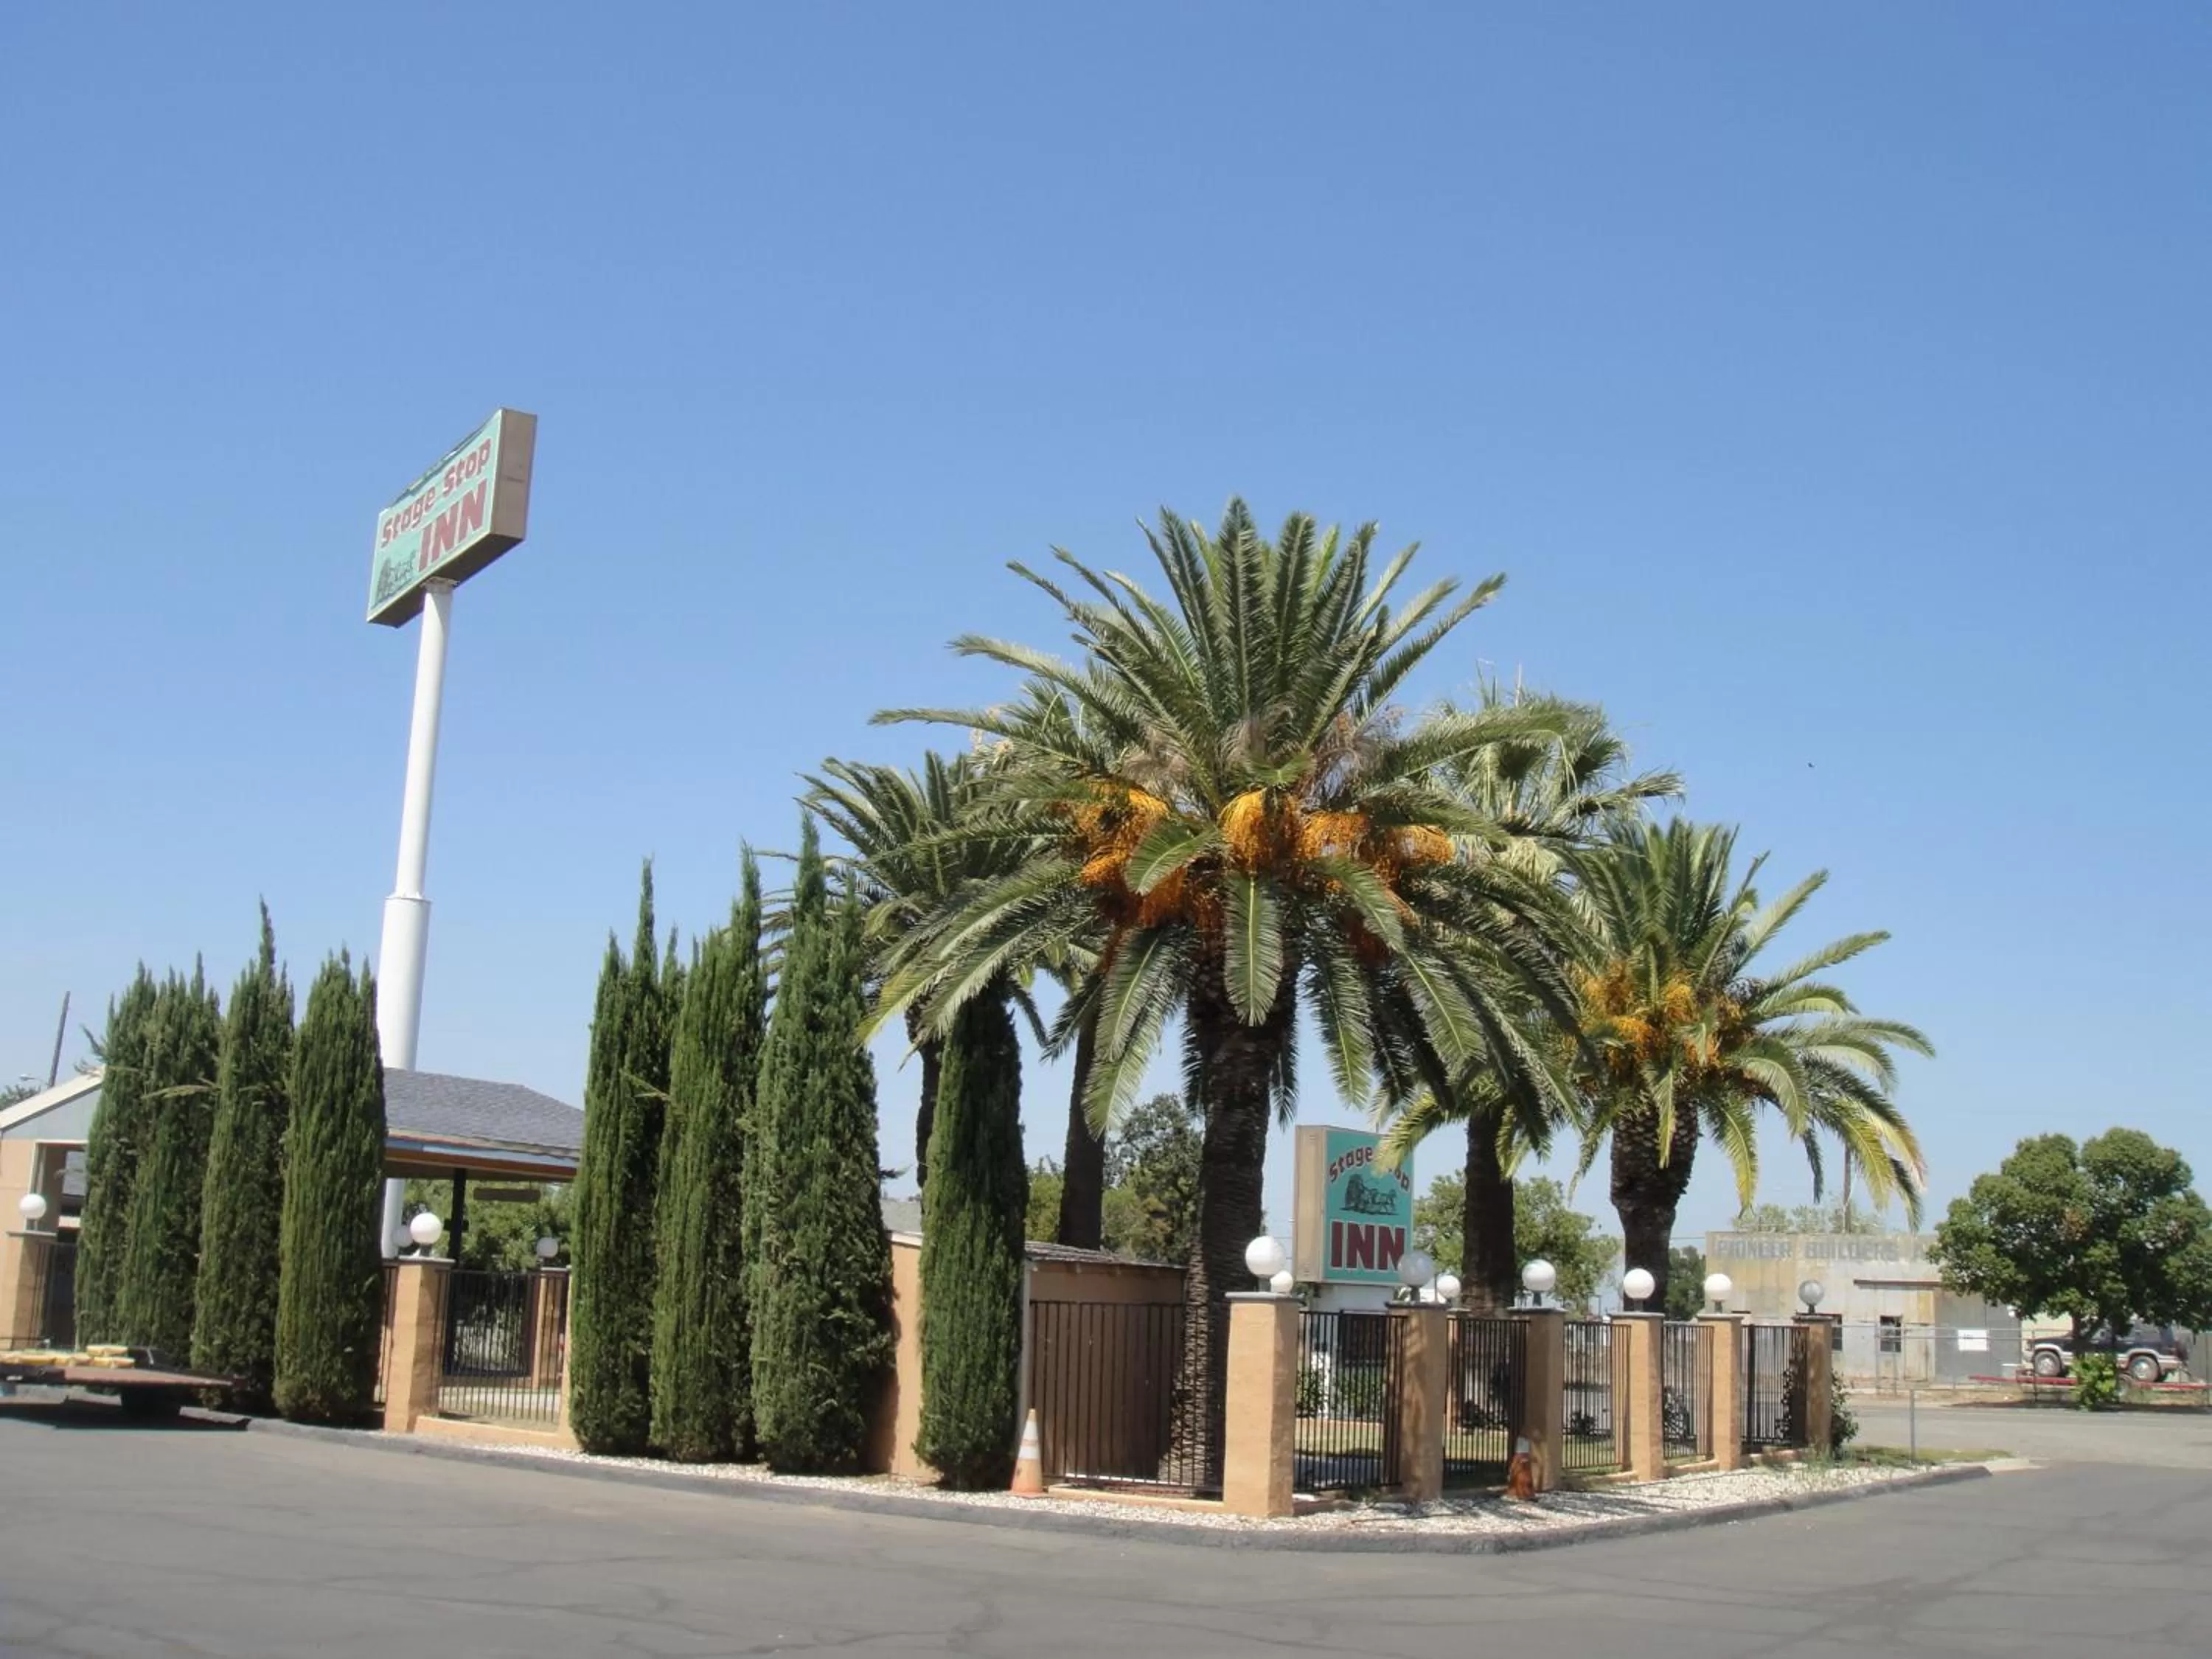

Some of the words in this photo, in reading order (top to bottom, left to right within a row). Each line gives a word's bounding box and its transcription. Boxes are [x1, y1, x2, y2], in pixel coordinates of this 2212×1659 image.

[379, 485, 437, 549] Stage
[442, 437, 493, 498] Stop
[417, 478, 488, 573] INN
[1329, 1145, 1374, 1184] Stage
[1330, 1220, 1406, 1272] INN
[1716, 1239, 1792, 1259] PIONEER
[1805, 1240, 1900, 1260] BUILDERS
